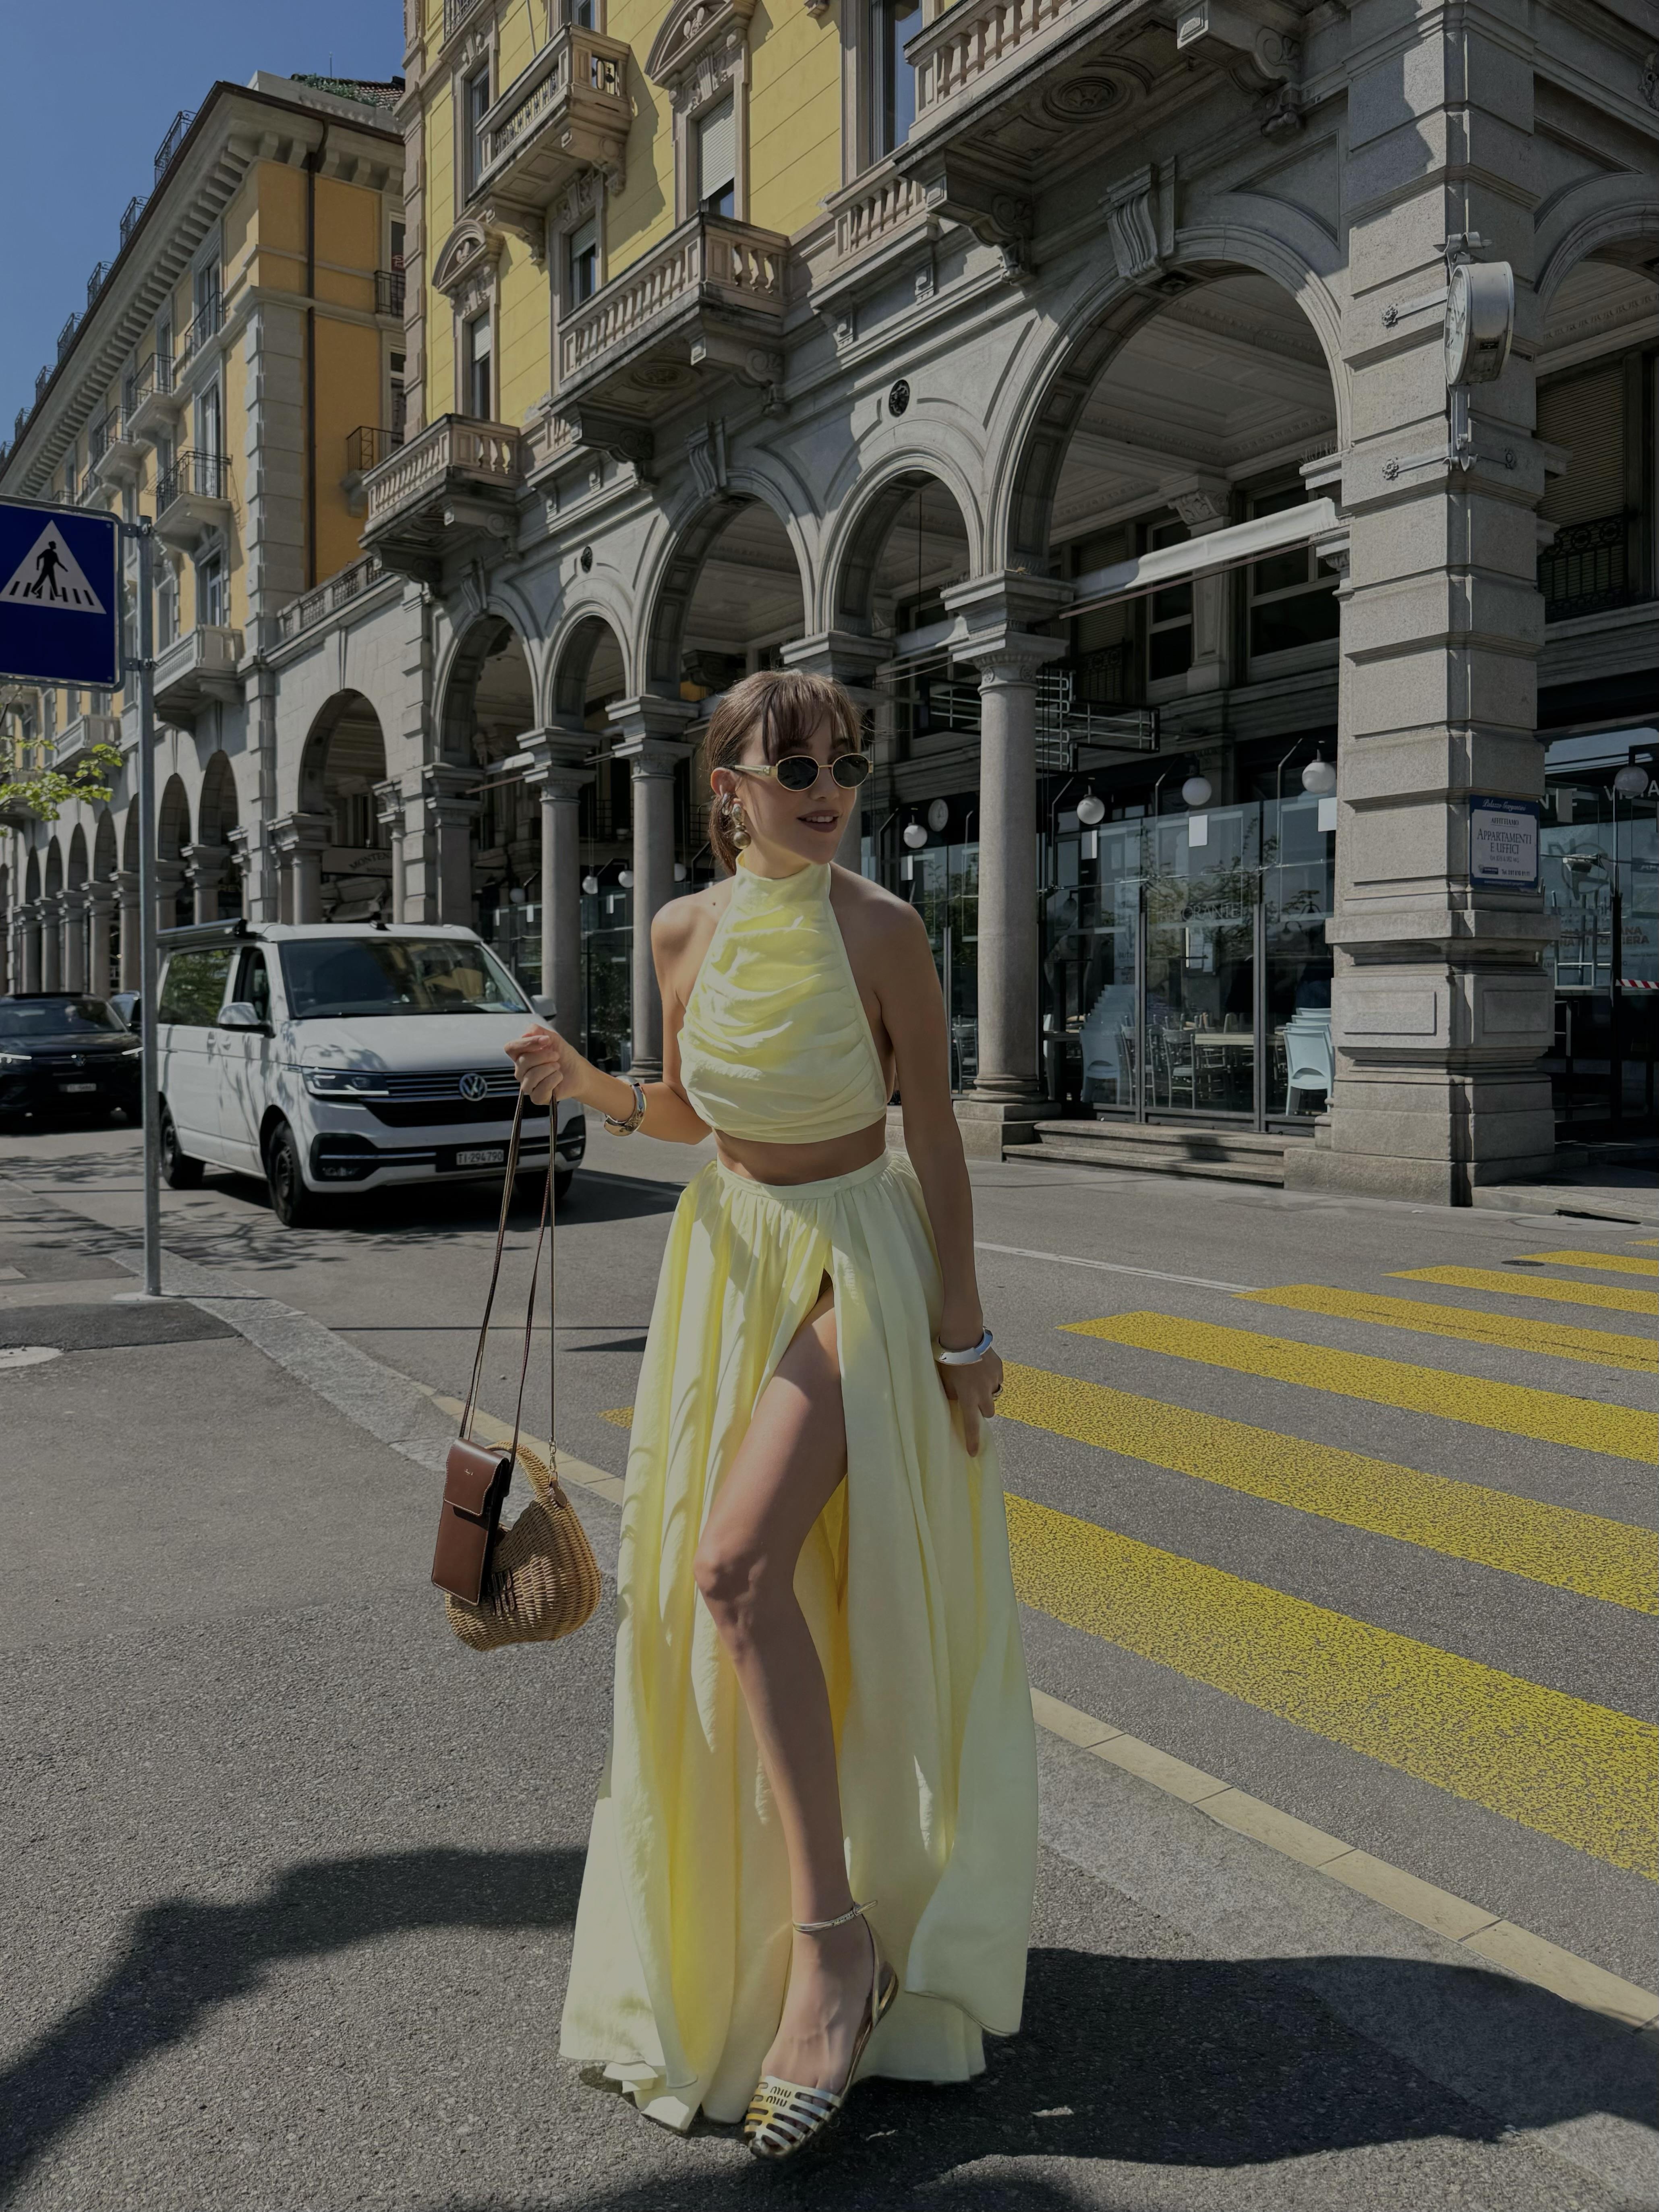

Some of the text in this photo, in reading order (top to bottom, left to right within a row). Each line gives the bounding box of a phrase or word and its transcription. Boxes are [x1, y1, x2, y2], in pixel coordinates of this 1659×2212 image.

[1477, 828, 1532, 844] APPARTAMENTI
[1490, 842, 1519, 854] E UFFICI
